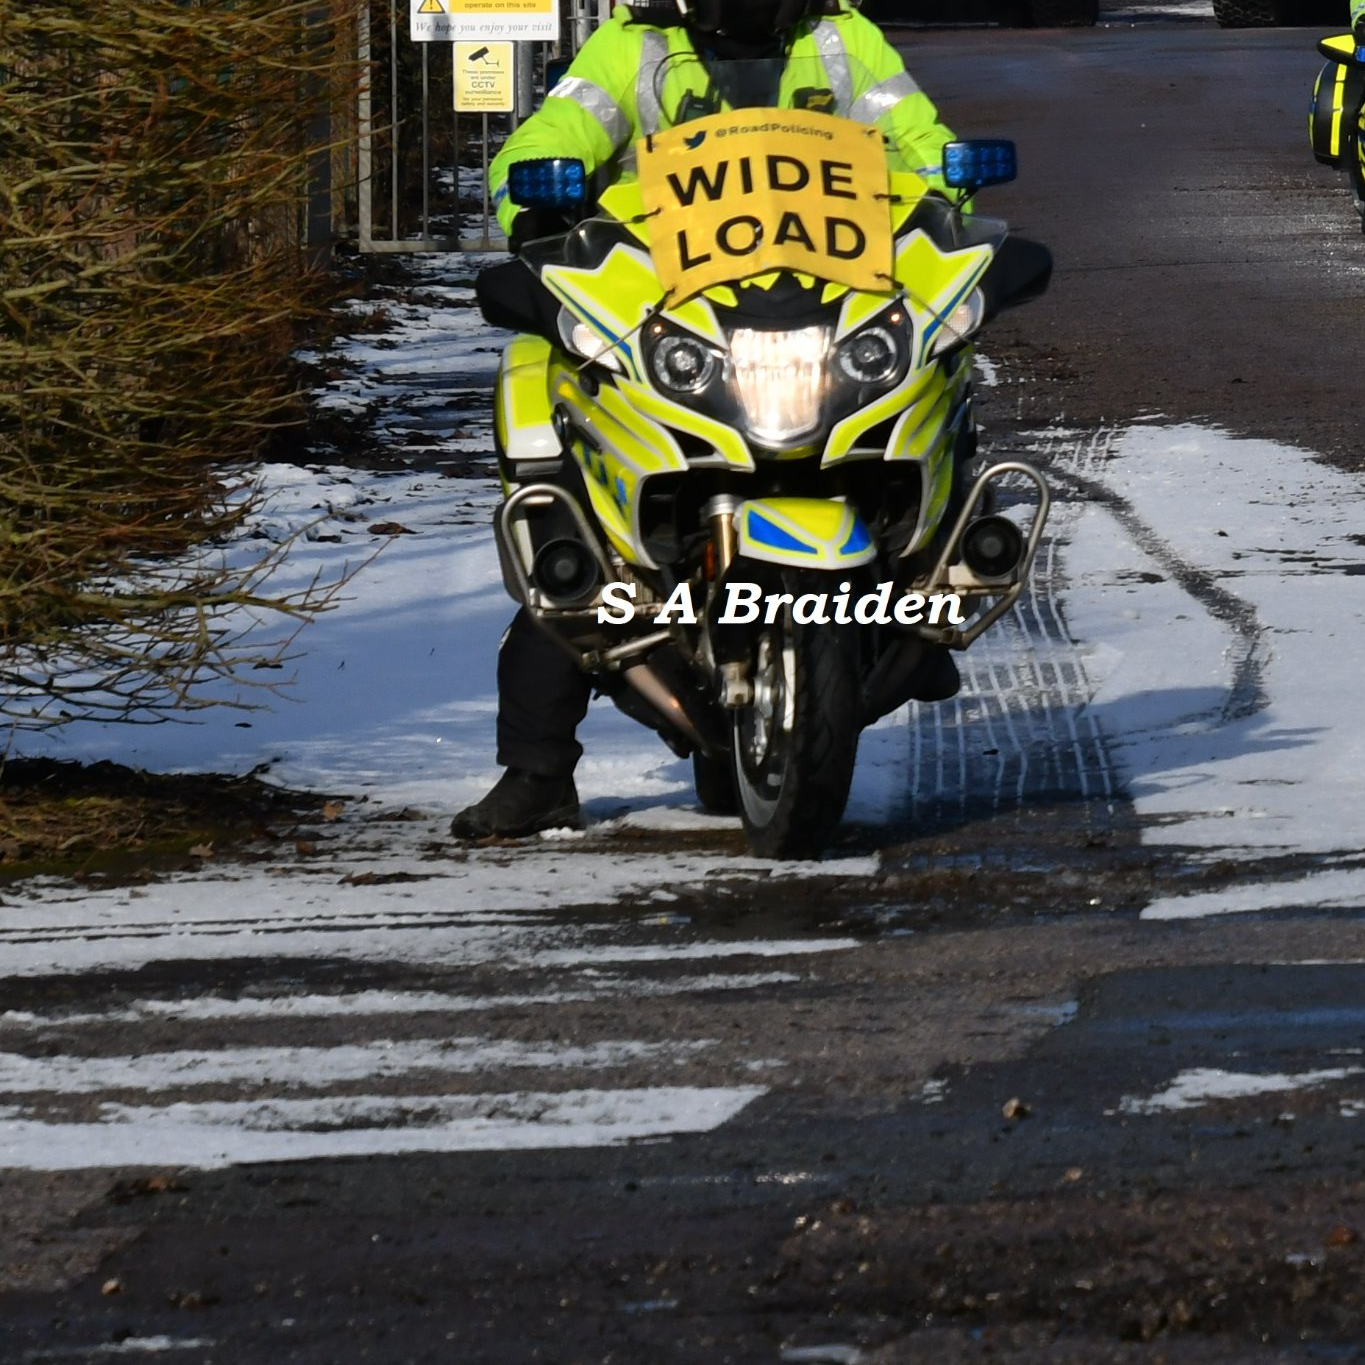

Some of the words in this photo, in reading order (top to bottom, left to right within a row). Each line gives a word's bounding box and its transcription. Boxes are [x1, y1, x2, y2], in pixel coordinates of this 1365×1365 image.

[416, 22, 432, 32] We
[434, 22, 456, 35] hope
[459, 24, 476, 34] you
[480, 22, 505, 34] enjoy
[507, 24, 530, 34] your
[532, 22, 552, 32] visit
[714, 123, 834, 140] @RoadPolicing
[666, 154, 858, 207] WIDE
[677, 210, 866, 272] LOAD
